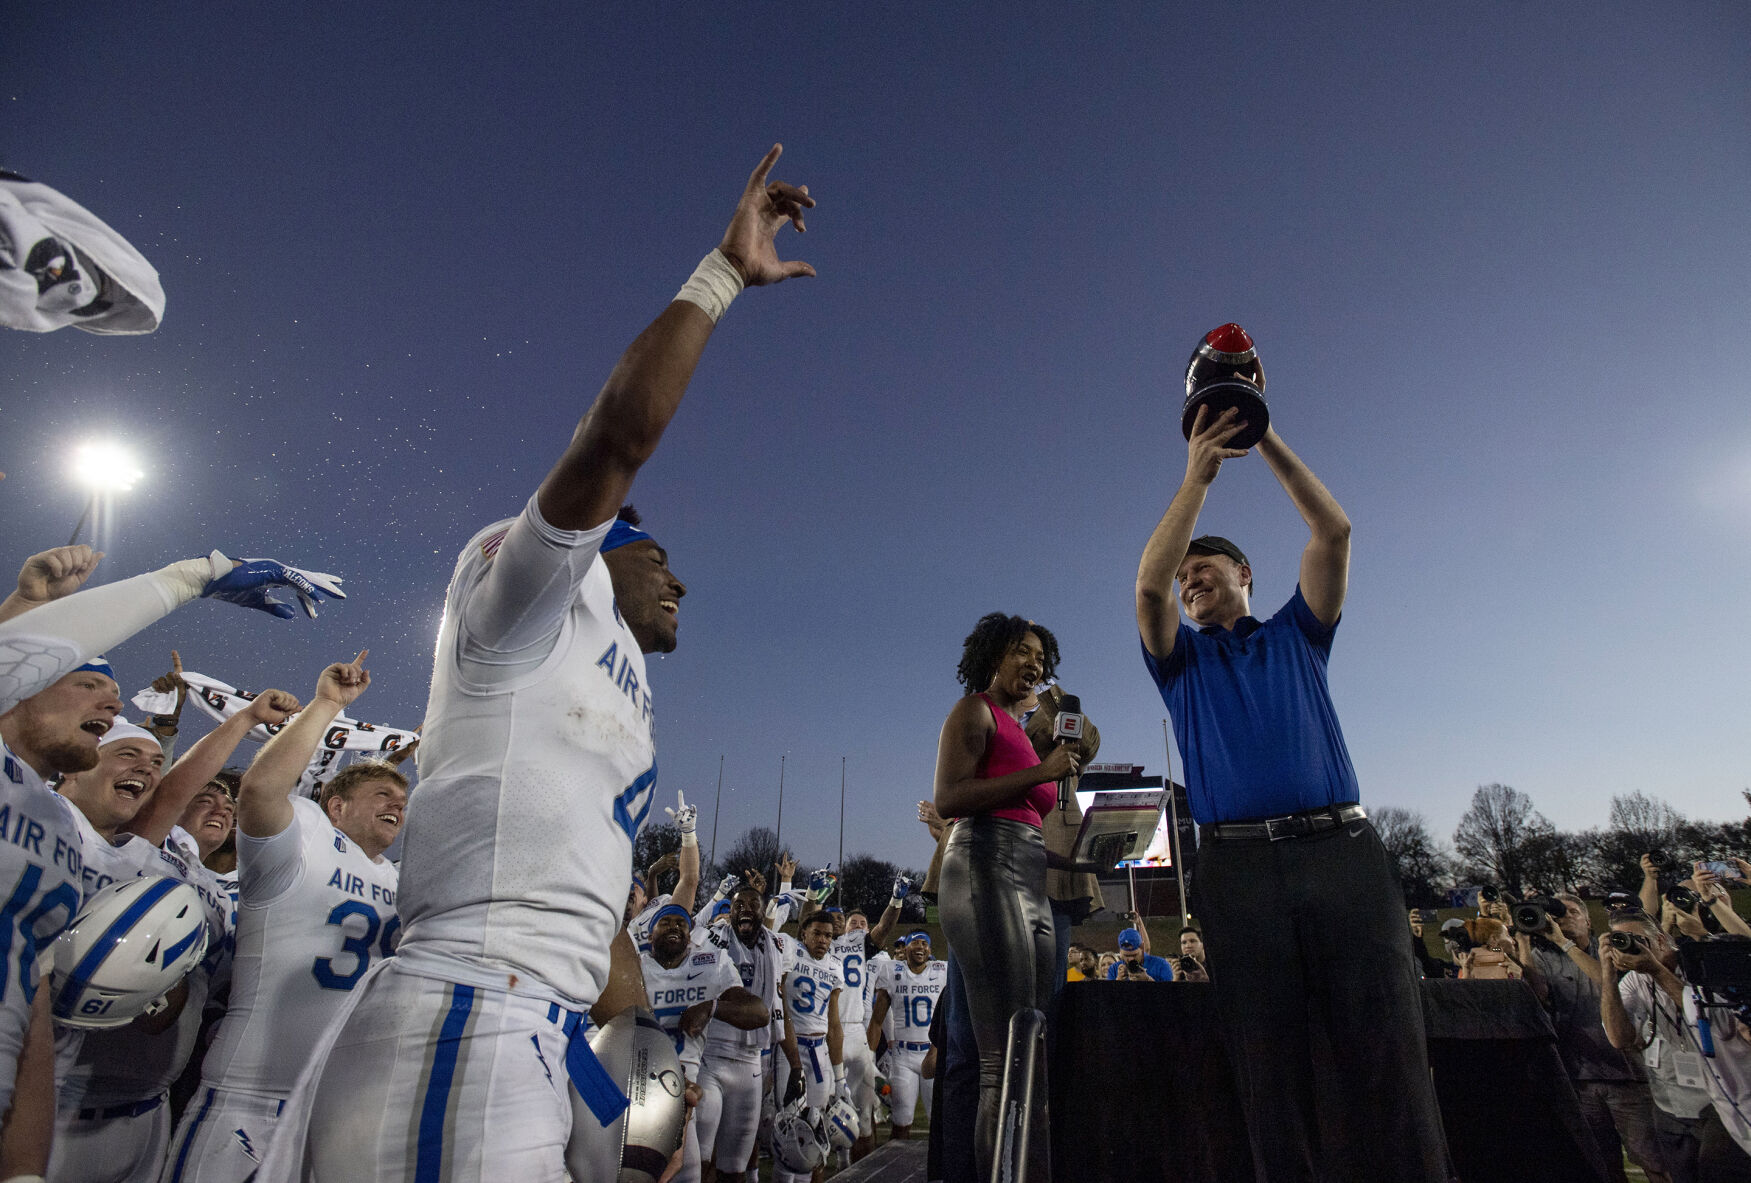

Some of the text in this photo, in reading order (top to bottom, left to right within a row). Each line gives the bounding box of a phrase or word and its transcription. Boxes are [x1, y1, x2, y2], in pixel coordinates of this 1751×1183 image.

[283, 567, 315, 594] FALCONS
[594, 639, 640, 708] AIR
[324, 726, 349, 749] G
[327, 866, 396, 907] AIR FO
[835, 942, 863, 954] FORCE
[793, 962, 838, 985] AIR FORCE
[654, 986, 707, 1005] FORCE
[792, 975, 833, 1016] 37
[895, 984, 940, 994] AIR FORCE
[81, 999, 114, 1015] 61
[904, 995, 932, 1028] 10
